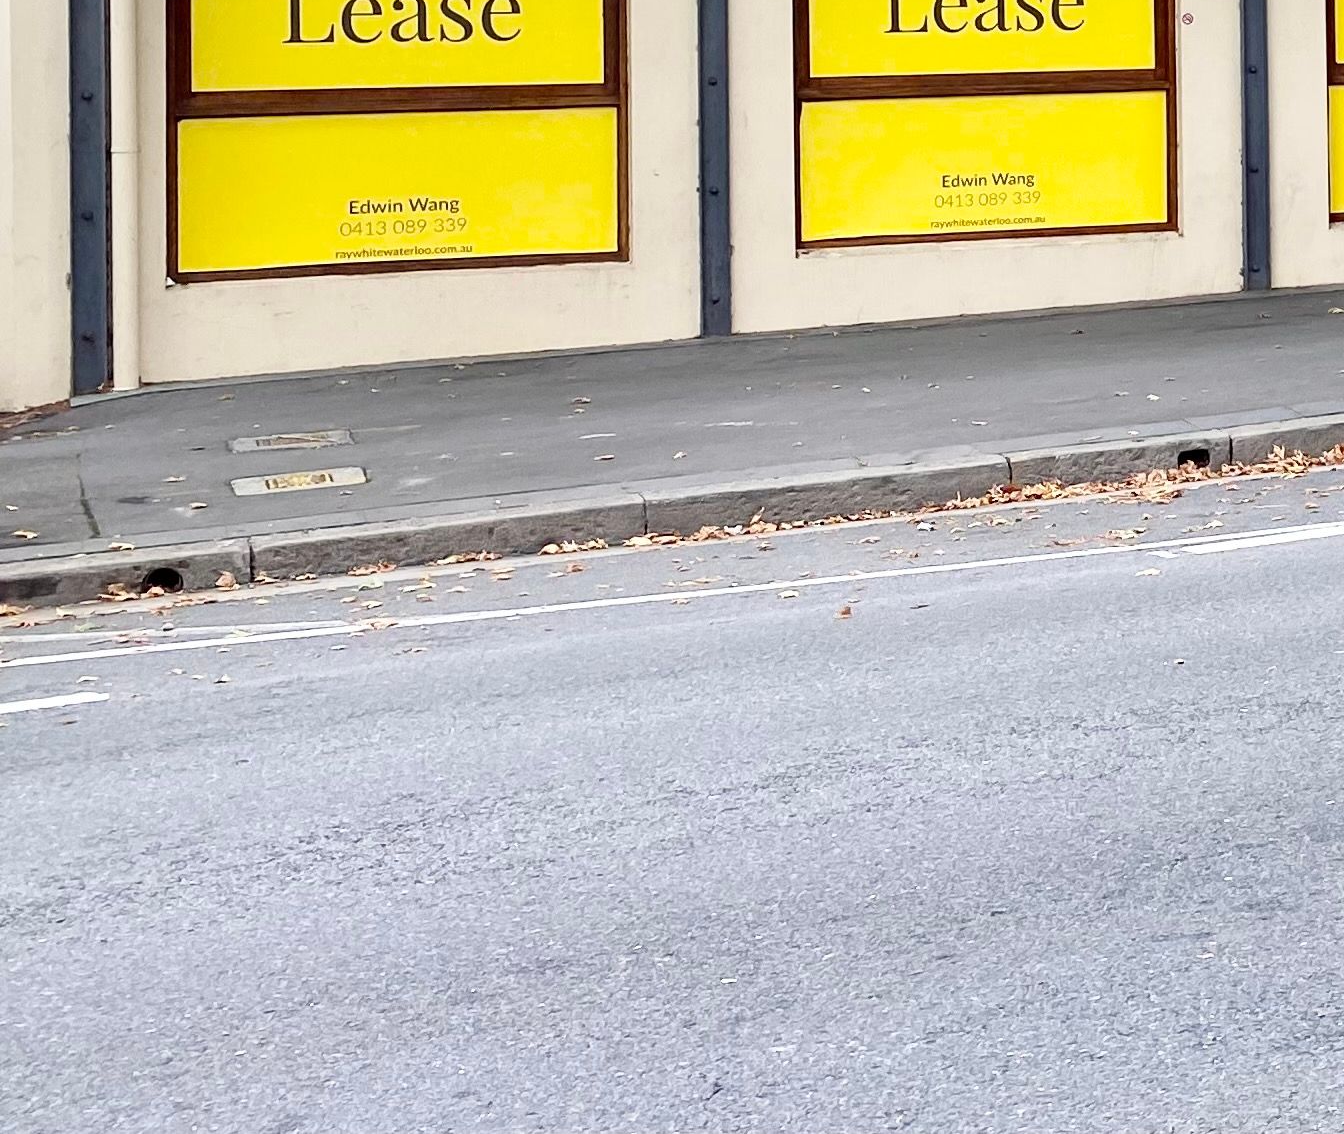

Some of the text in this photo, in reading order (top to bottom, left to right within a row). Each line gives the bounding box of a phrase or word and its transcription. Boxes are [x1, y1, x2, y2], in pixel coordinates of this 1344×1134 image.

[942, 172, 1035, 188] Edwin Wang
[349, 197, 460, 215] Edwin Wang
[934, 190, 1041, 208] 0413 089 339
[339, 217, 467, 237] 0413 089 339
[930, 216, 1046, 229] raywhitewaterloo.com.au
[335, 245, 473, 259] raywhitewaterloo.com.au
